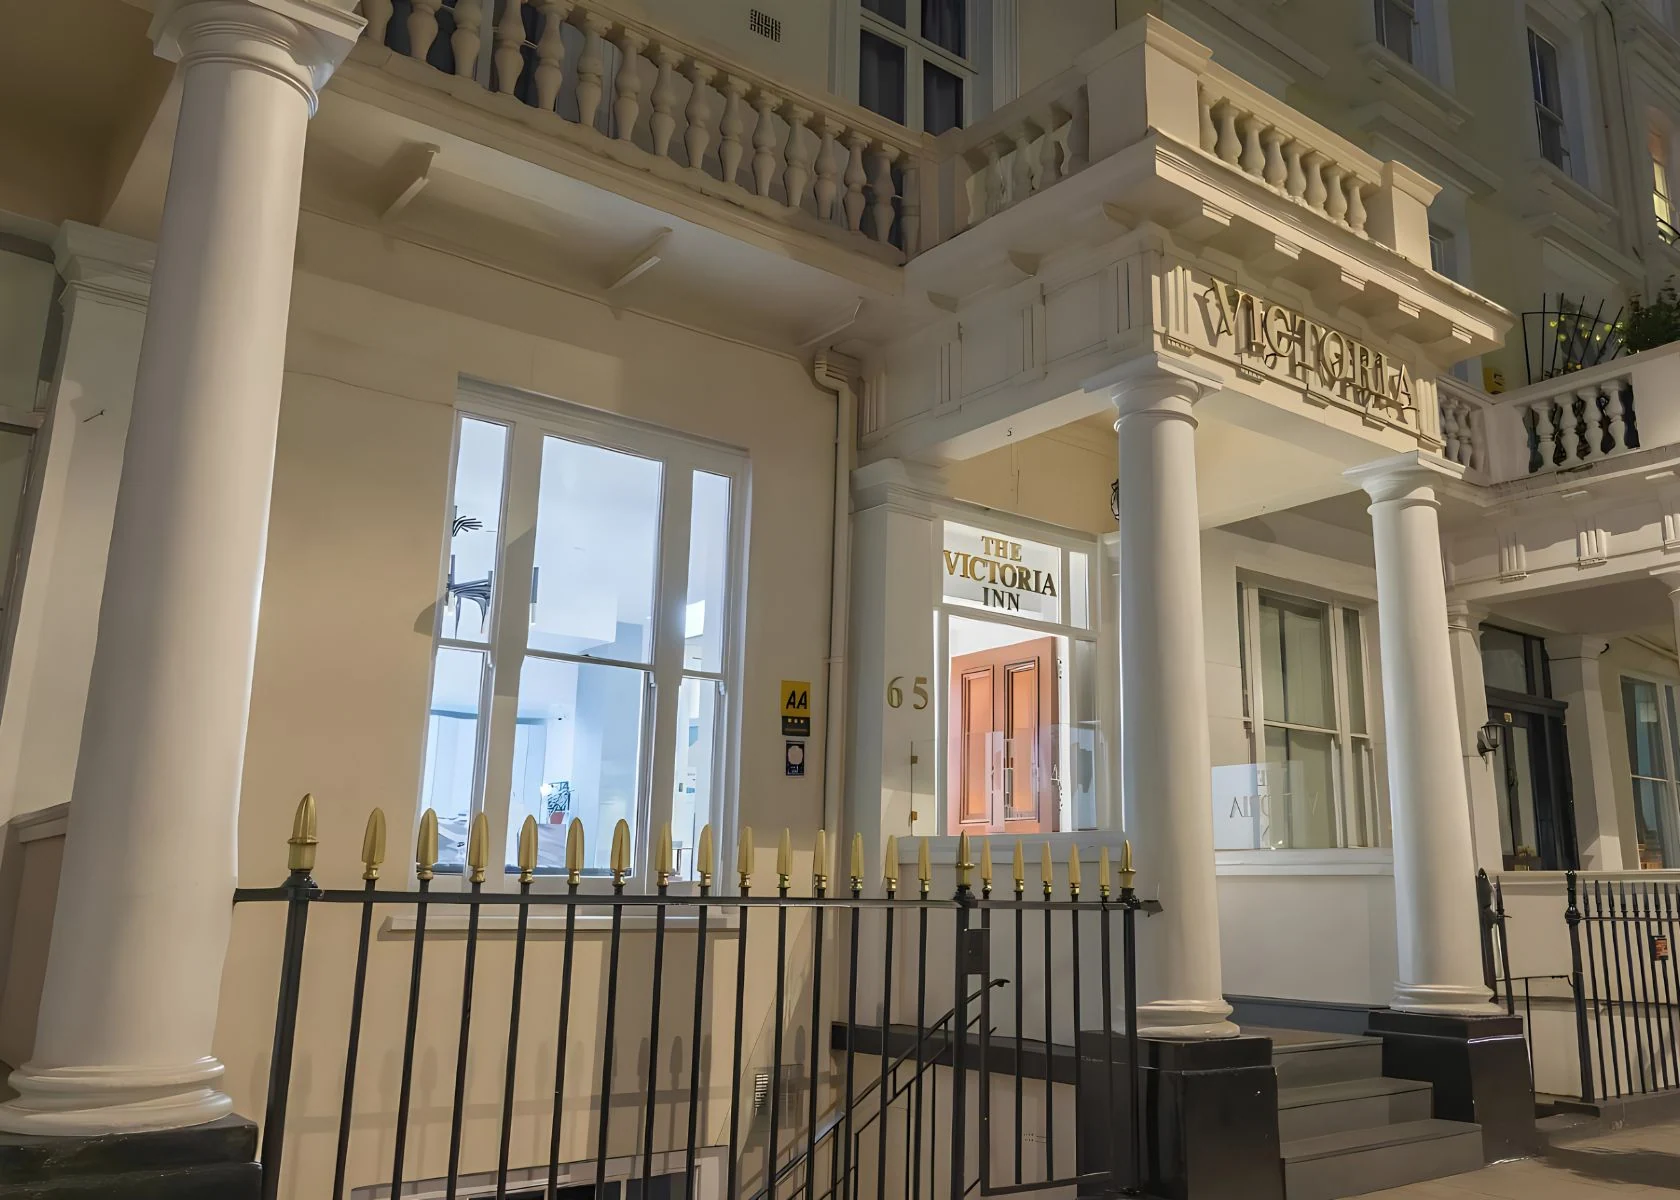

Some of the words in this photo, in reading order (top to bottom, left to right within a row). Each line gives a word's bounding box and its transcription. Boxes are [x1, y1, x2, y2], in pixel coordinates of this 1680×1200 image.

[1203, 277, 1413, 408] VICTORIA
[981, 536, 1022, 562] THE
[943, 549, 1057, 597] VICTORIA
[982, 586, 1020, 612] INN
[785, 690, 808, 710] AA
[887, 676, 929, 710] 65
